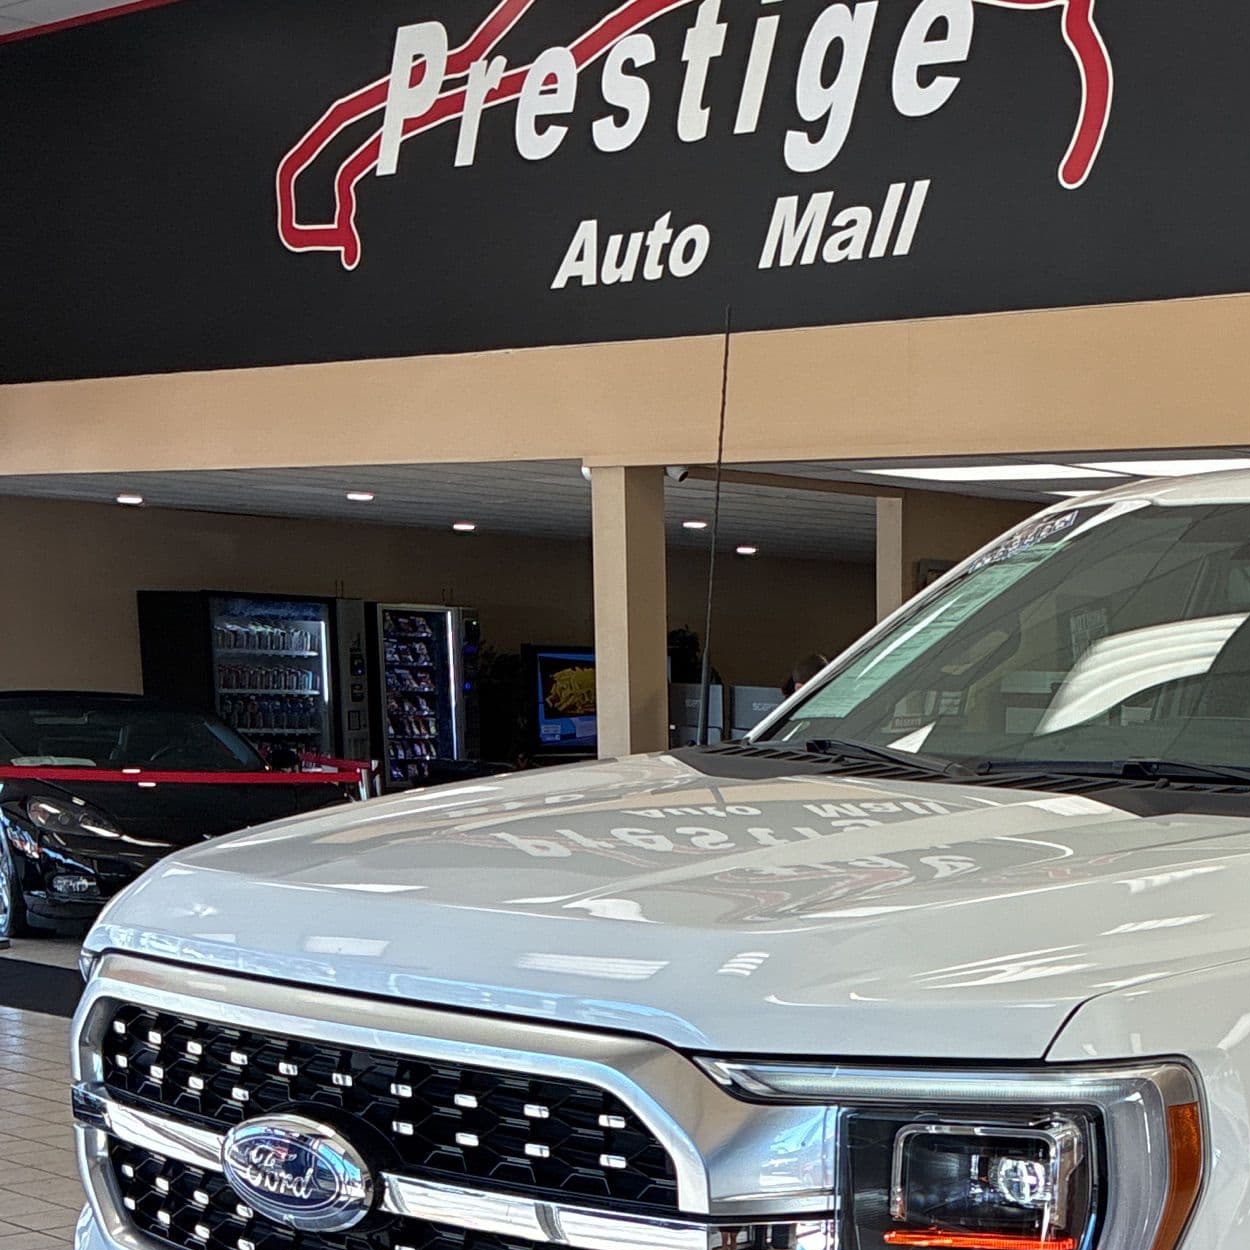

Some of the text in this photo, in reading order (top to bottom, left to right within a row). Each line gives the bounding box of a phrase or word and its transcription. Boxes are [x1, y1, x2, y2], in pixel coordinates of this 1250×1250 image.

[375, 0, 975, 175] Prestige
[550, 179, 931, 290] Auto Mall
[247, 1144, 314, 1199] Ford
